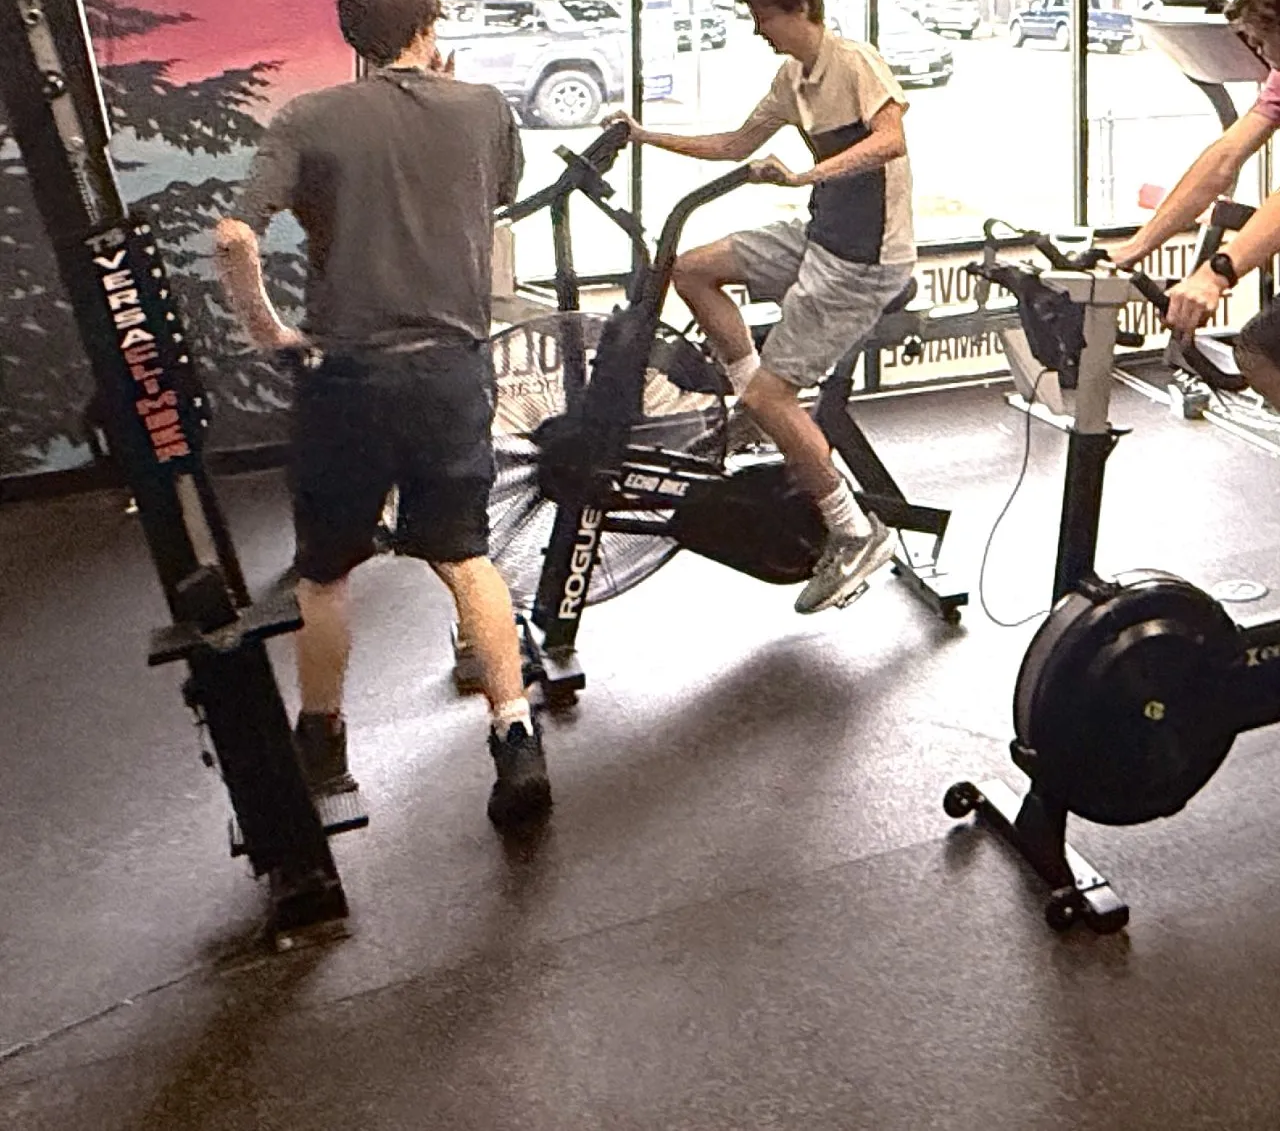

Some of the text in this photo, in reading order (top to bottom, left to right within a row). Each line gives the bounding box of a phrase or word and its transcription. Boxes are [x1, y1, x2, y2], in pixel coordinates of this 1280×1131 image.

[624, 472, 691, 497] ECHO BIKE
[558, 505, 602, 620] ROGUE
